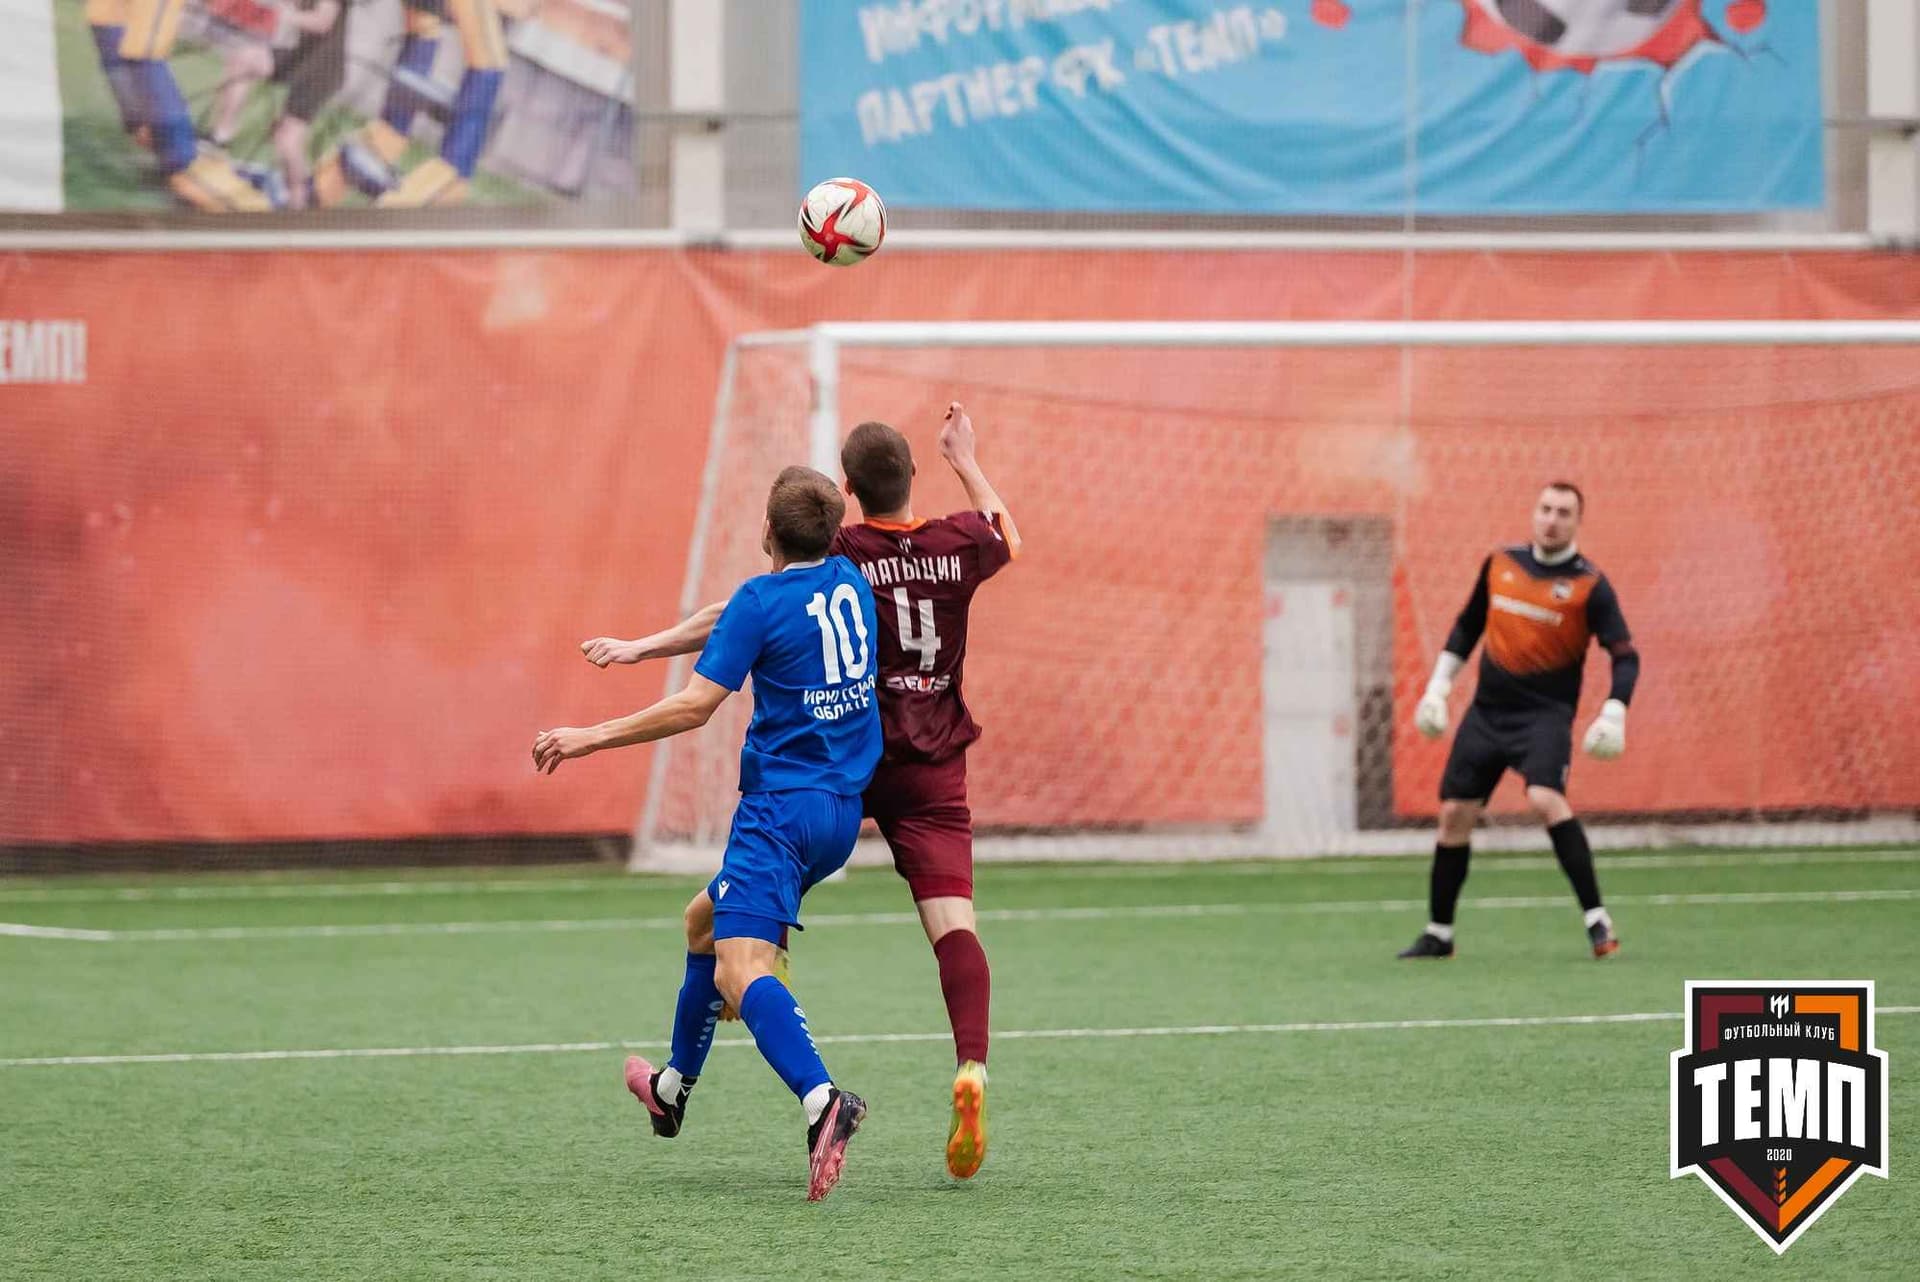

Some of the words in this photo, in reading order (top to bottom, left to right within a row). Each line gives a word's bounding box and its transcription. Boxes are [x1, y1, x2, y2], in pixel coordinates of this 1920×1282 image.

[856, 56, 1042, 147] ПАРТНЕР
[860, 555, 962, 587] МАТЫЦИН
[806, 583, 869, 685] 10
[893, 587, 942, 672] 4
